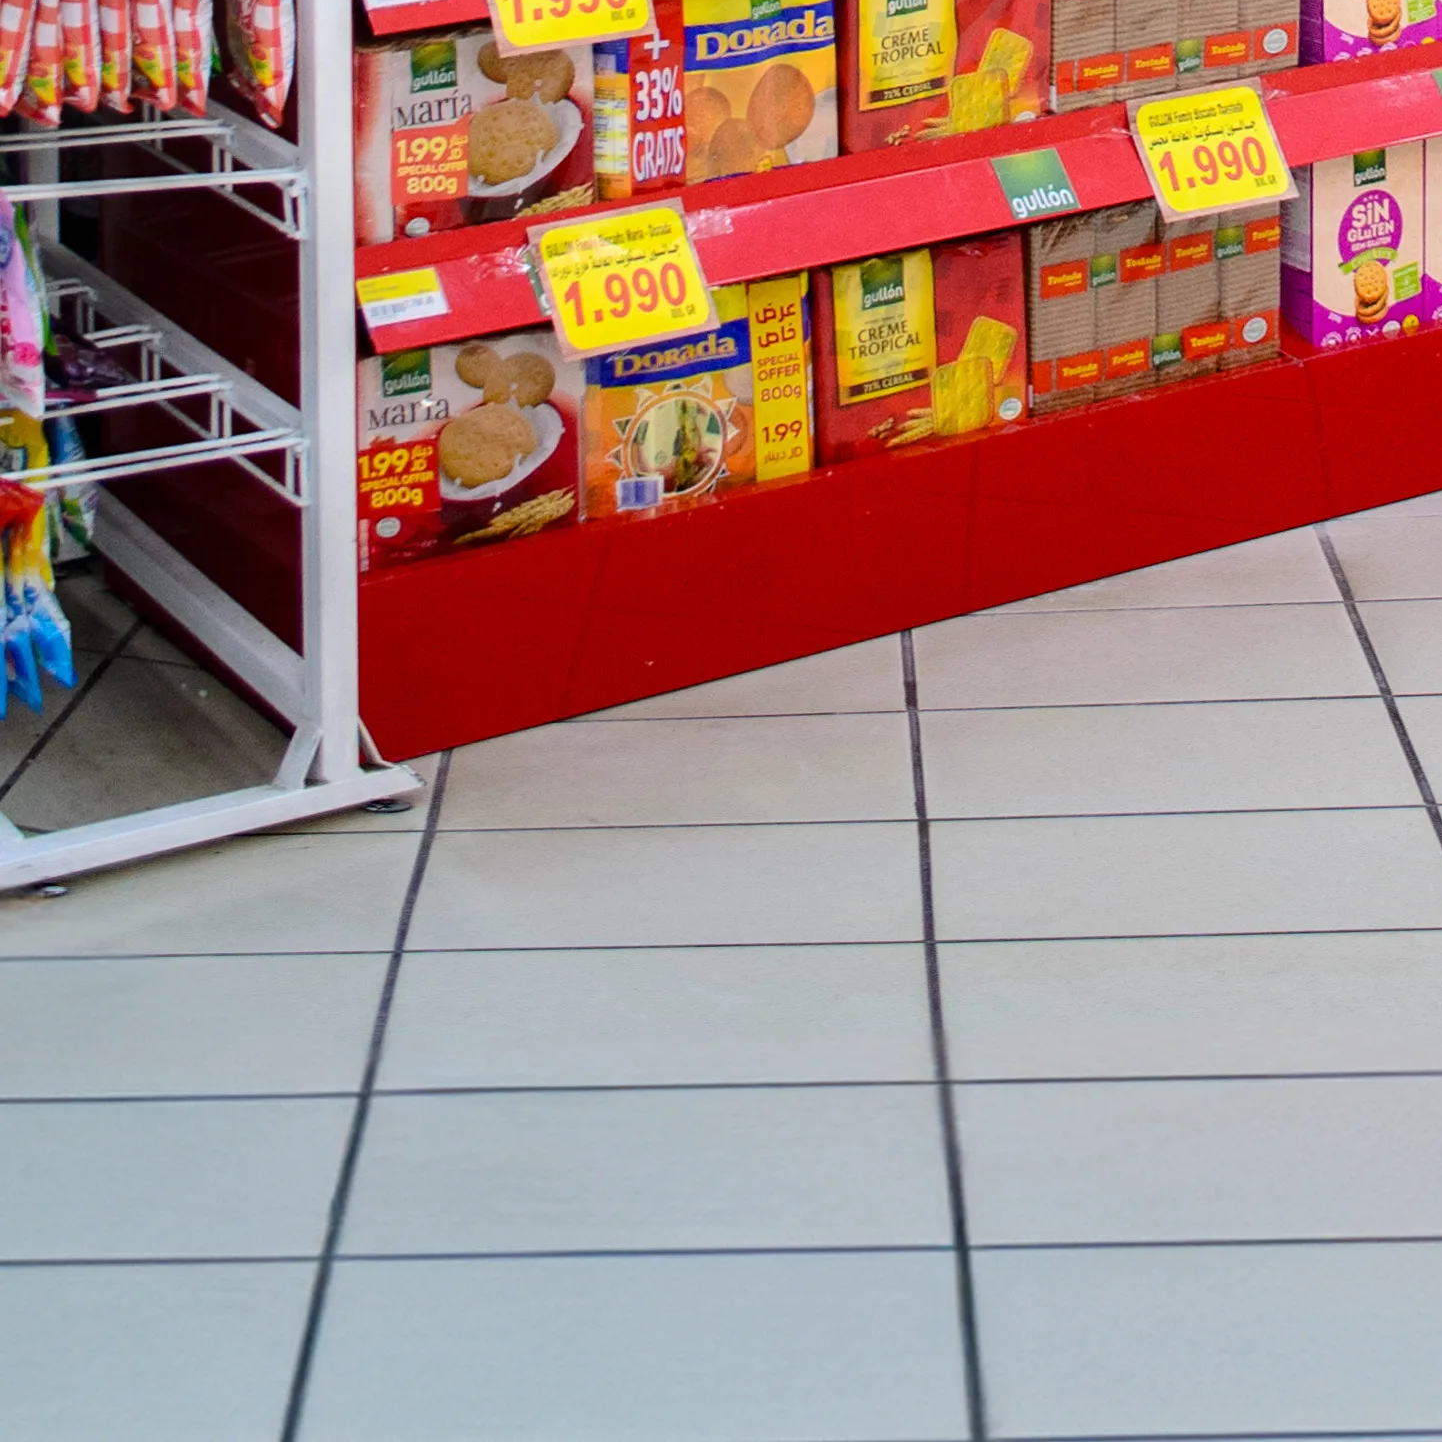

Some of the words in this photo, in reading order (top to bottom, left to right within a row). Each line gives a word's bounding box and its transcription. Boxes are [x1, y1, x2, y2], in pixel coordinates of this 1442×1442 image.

[696, 10, 834, 60] Dorada
[881, 28, 929, 50] CREME
[872, 41, 945, 66] TROPICAL
[413, 69, 456, 92] gullón
[634, 66, 683, 122] 33%
[394, 90, 473, 130] María
[396, 136, 445, 165] 1.99
[632, 126, 685, 182] GRATIS
[1159, 136, 1267, 192] 1.990
[406, 175, 458, 194] 800g
[1012, 184, 1075, 219] gullón
[564, 261, 687, 328] 1.990
[863, 284, 903, 309] gullón
[856, 318, 909, 343] CREME
[612, 333, 737, 378] Dorada
[848, 331, 922, 360] TROPICAL
[757, 352, 800, 368] SPECIAL
[758, 364, 800, 381] OFFER
[760, 385, 802, 402] 800g
[763, 420, 803, 443] 1.99
[359, 449, 410, 479] 1.99
[371, 487, 424, 507] 800g
